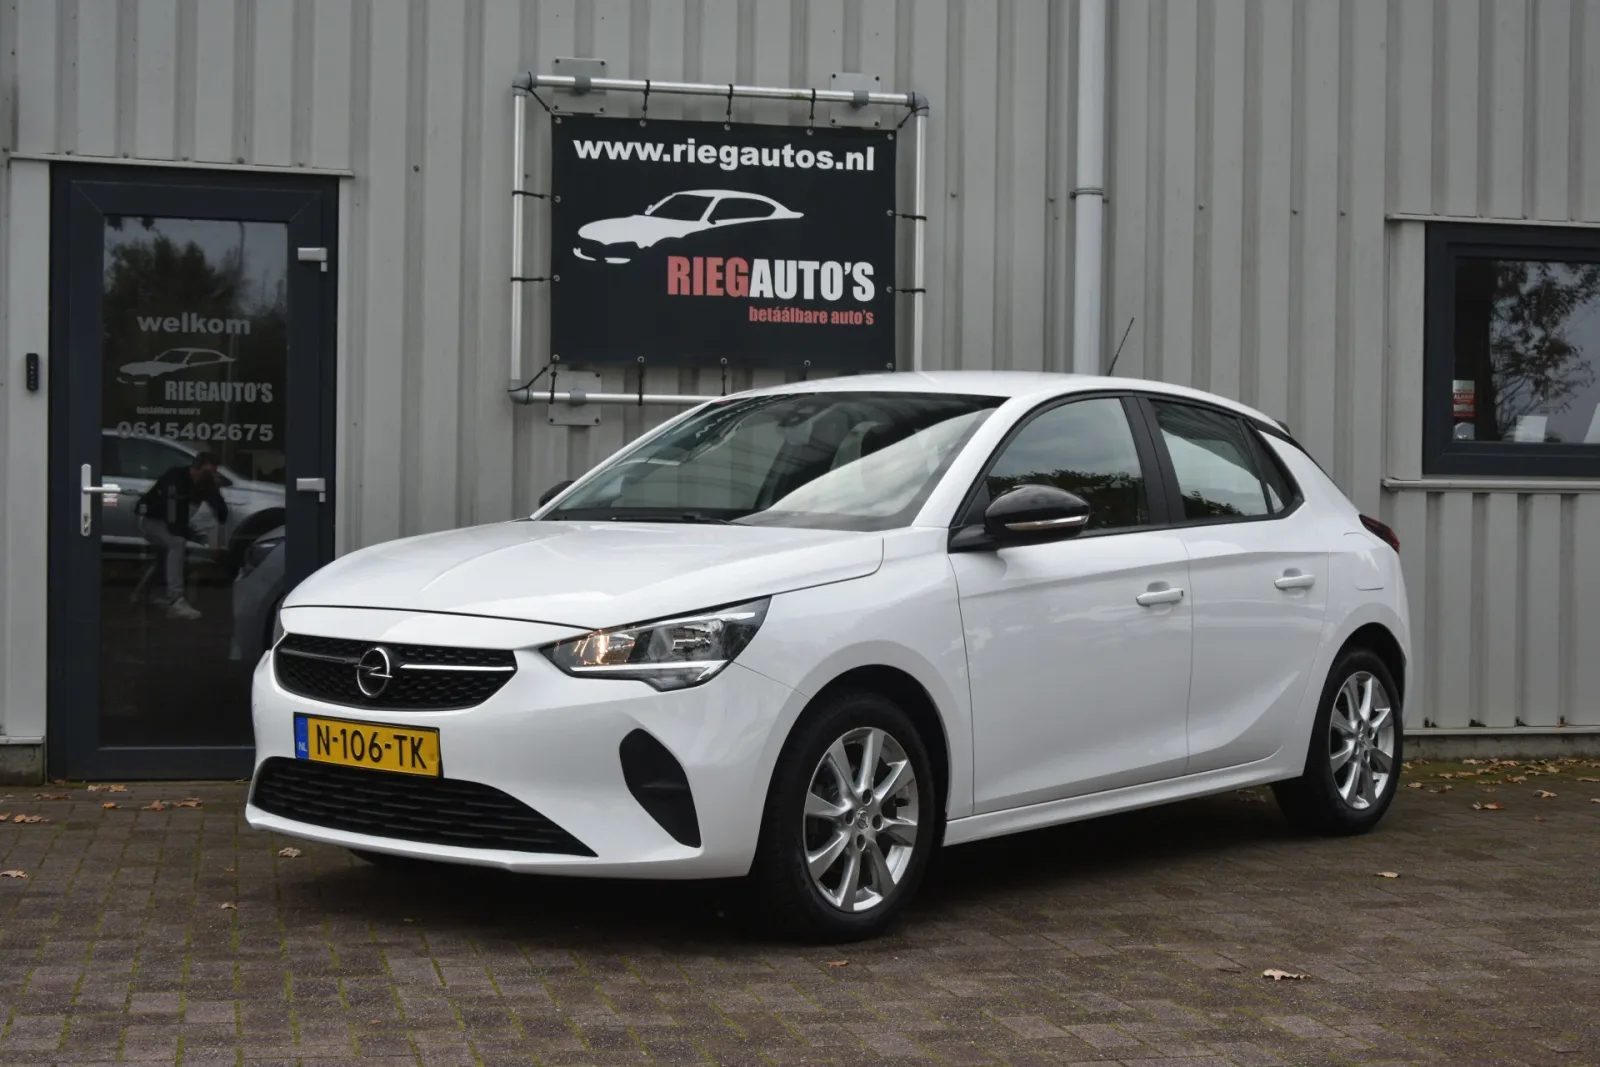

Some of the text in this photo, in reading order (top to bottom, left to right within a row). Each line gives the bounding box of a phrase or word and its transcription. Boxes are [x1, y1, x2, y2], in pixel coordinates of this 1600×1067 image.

[573, 138, 875, 171] www.riegautos.nl
[667, 255, 876, 302] RIEGAUTO'S
[137, 312, 250, 334] welkom
[749, 306, 874, 325] betáálbare auto's
[165, 380, 273, 403] RIEGAUTO'S
[116, 421, 274, 441] 0615402675
[299, 741, 307, 752] NL
[316, 724, 427, 769] N-106-TK
